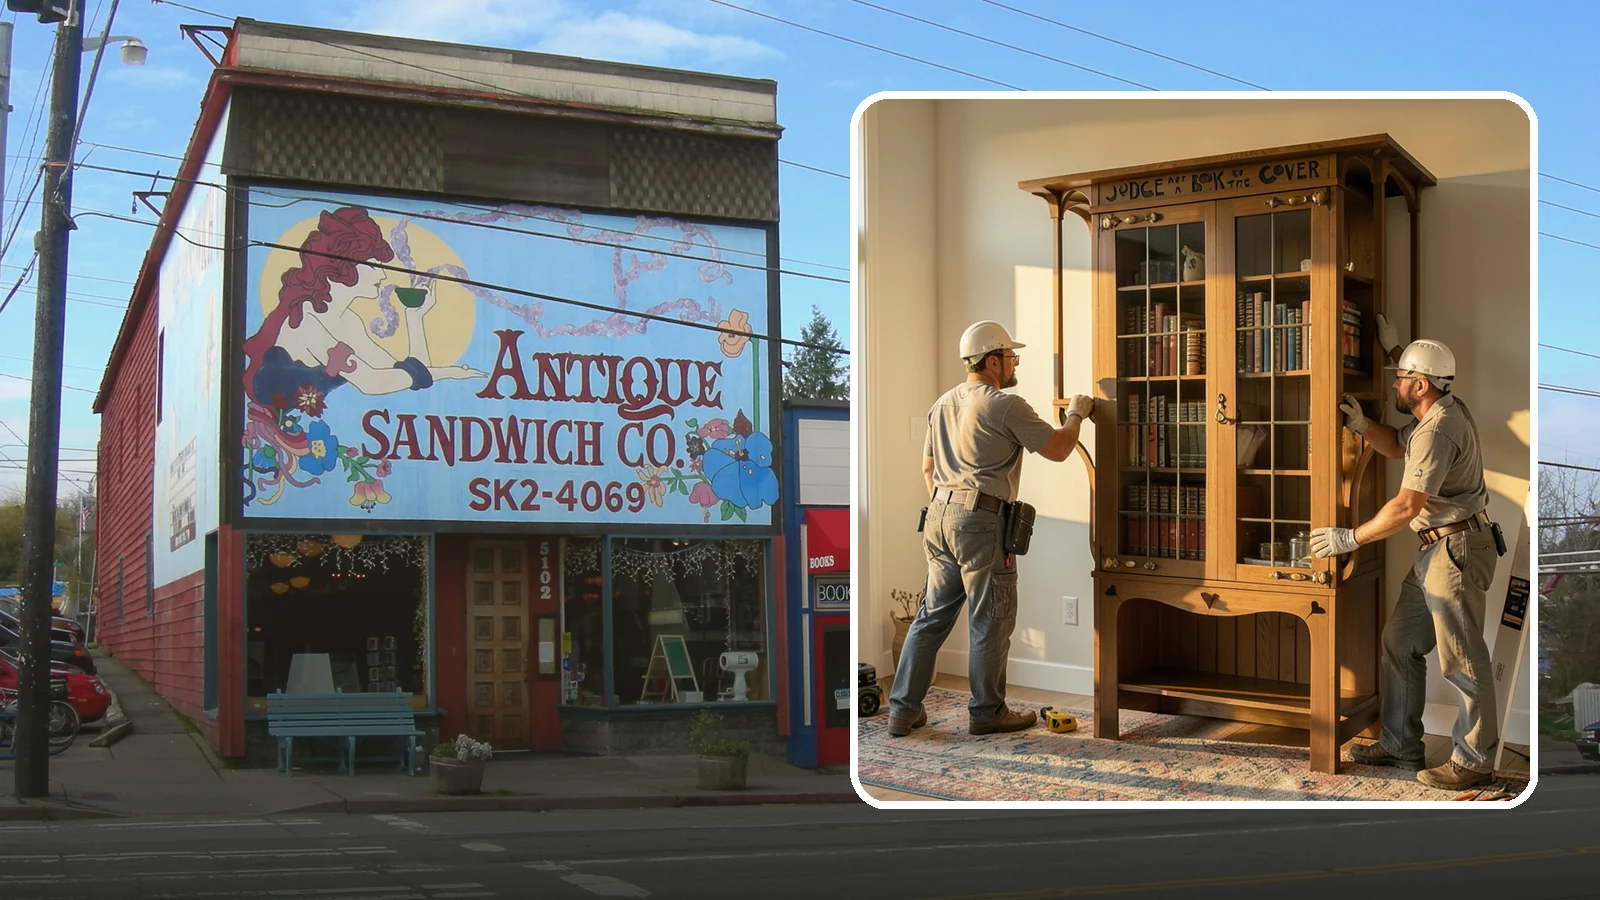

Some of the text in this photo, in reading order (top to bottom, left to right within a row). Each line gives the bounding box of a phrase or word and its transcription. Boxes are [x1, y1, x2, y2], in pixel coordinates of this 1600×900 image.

[1105, 178, 1165, 202] JUDGE
[1259, 160, 1320, 185] COVER
[475, 328, 724, 421] ANTIQUE
[361, 408, 685, 468] SANDWICH CO.
[469, 477, 646, 513] SK2-4069
[539, 541, 552, 600] 5102
[809, 554, 835, 569] BOOKS
